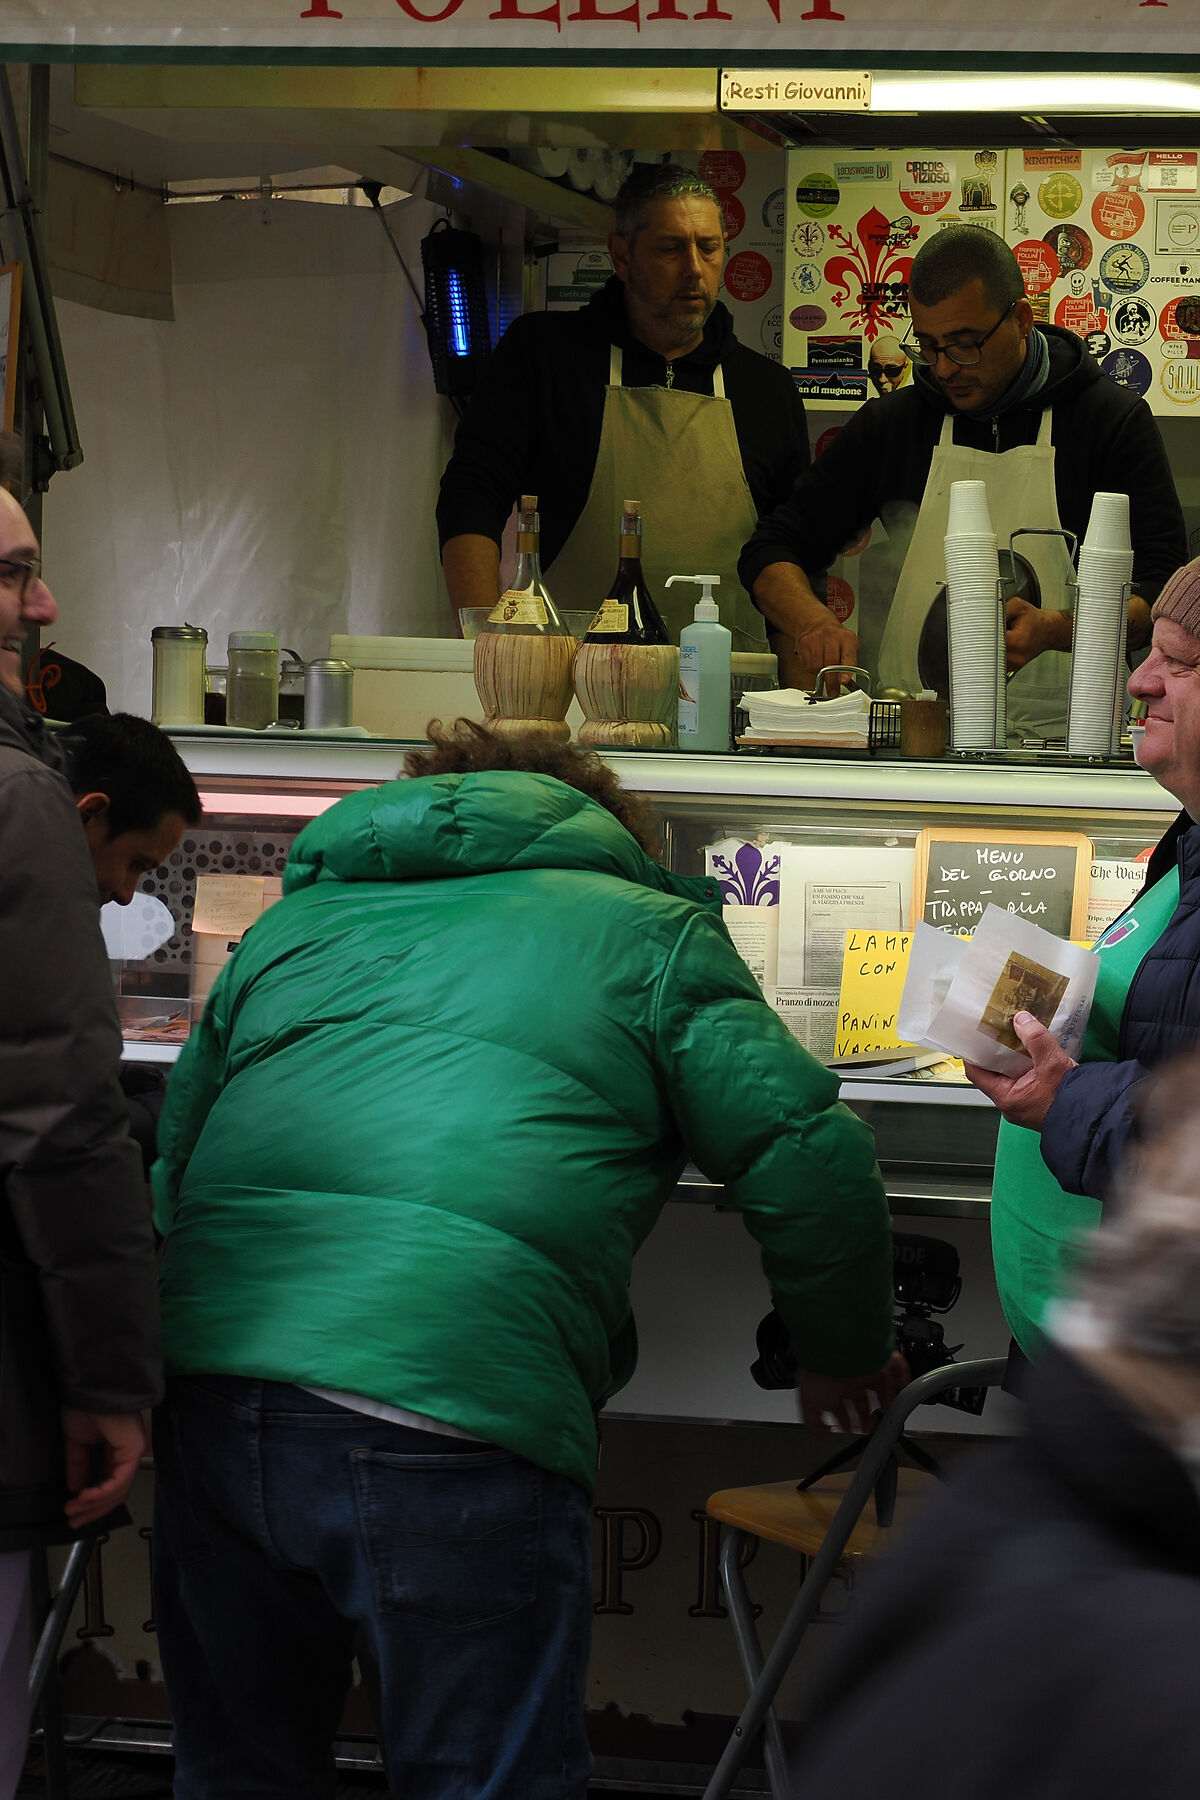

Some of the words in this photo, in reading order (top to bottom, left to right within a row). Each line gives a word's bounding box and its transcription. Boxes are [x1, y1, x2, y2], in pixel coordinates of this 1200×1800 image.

[730, 82, 777, 101] Resti
[784, 82, 861, 101] Giovanni
[811, 385, 820, 394] di
[820, 386, 862, 396] mugnone
[976, 848, 1024, 865] MENU
[940, 865, 970, 882] DEL
[1090, 865, 1111, 880] The
[1088, 914, 1104, 922] Tripe,
[848, 934, 909, 952] LAMP
[860, 961, 896, 976] CON
[776, 996, 804, 1006] Pranzo
[804, 997, 812, 1006] di
